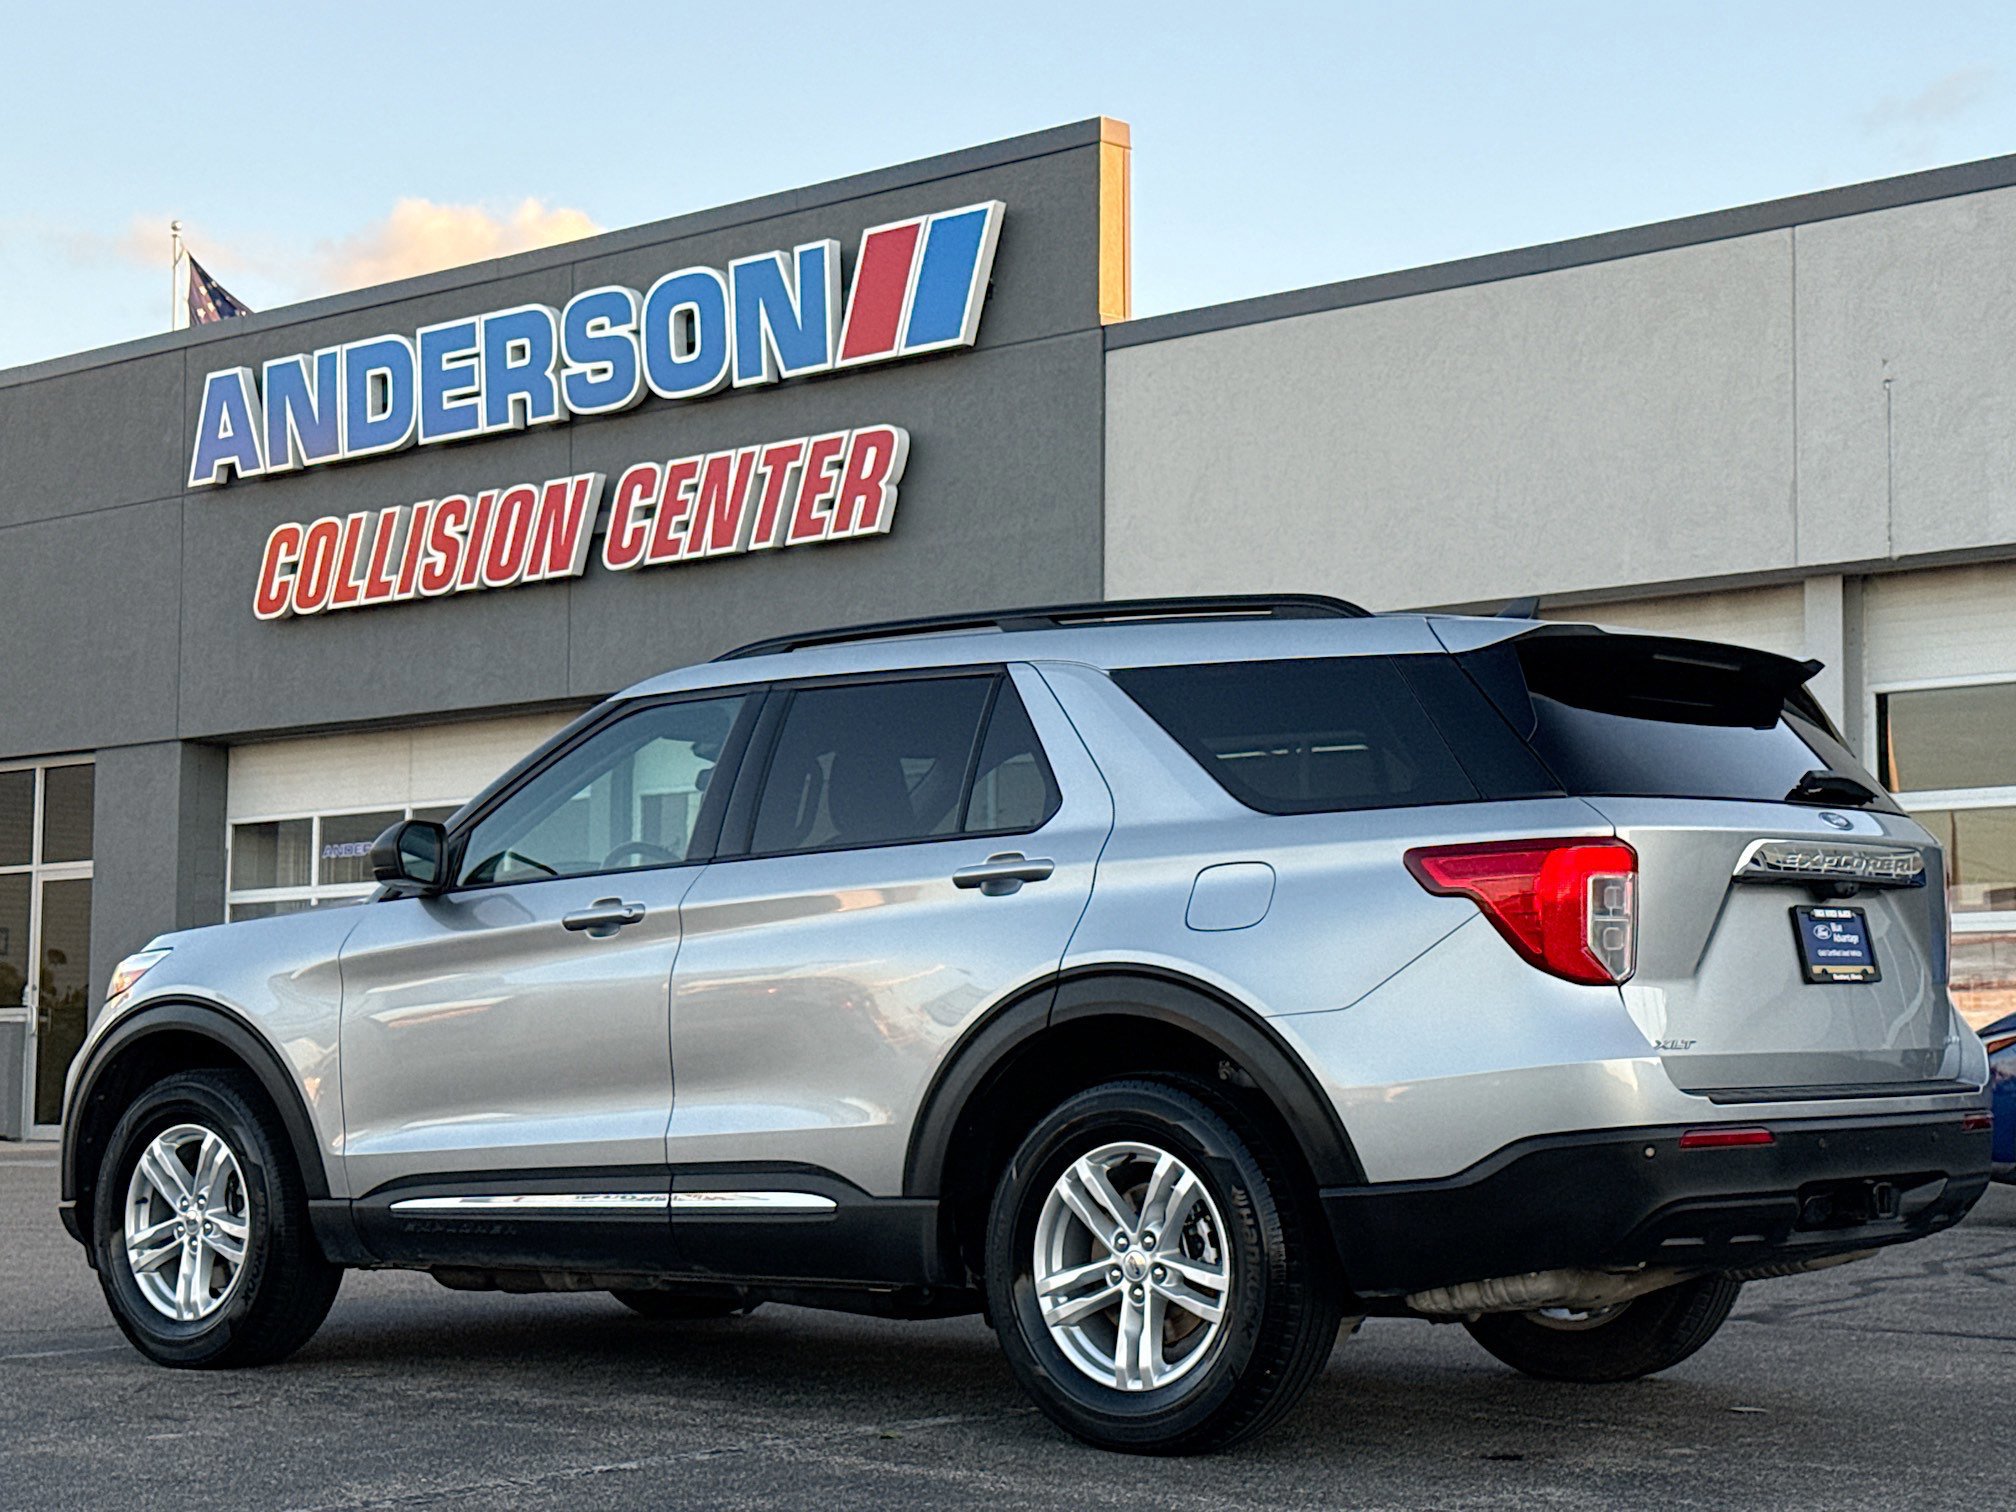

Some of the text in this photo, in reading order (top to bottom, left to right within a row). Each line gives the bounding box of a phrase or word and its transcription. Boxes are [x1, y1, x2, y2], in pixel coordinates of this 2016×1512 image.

[188, 238, 842, 488] ANDERSON
[253, 423, 911, 621] COLLISION CENTER
[1653, 1039, 1697, 1051] XLT
